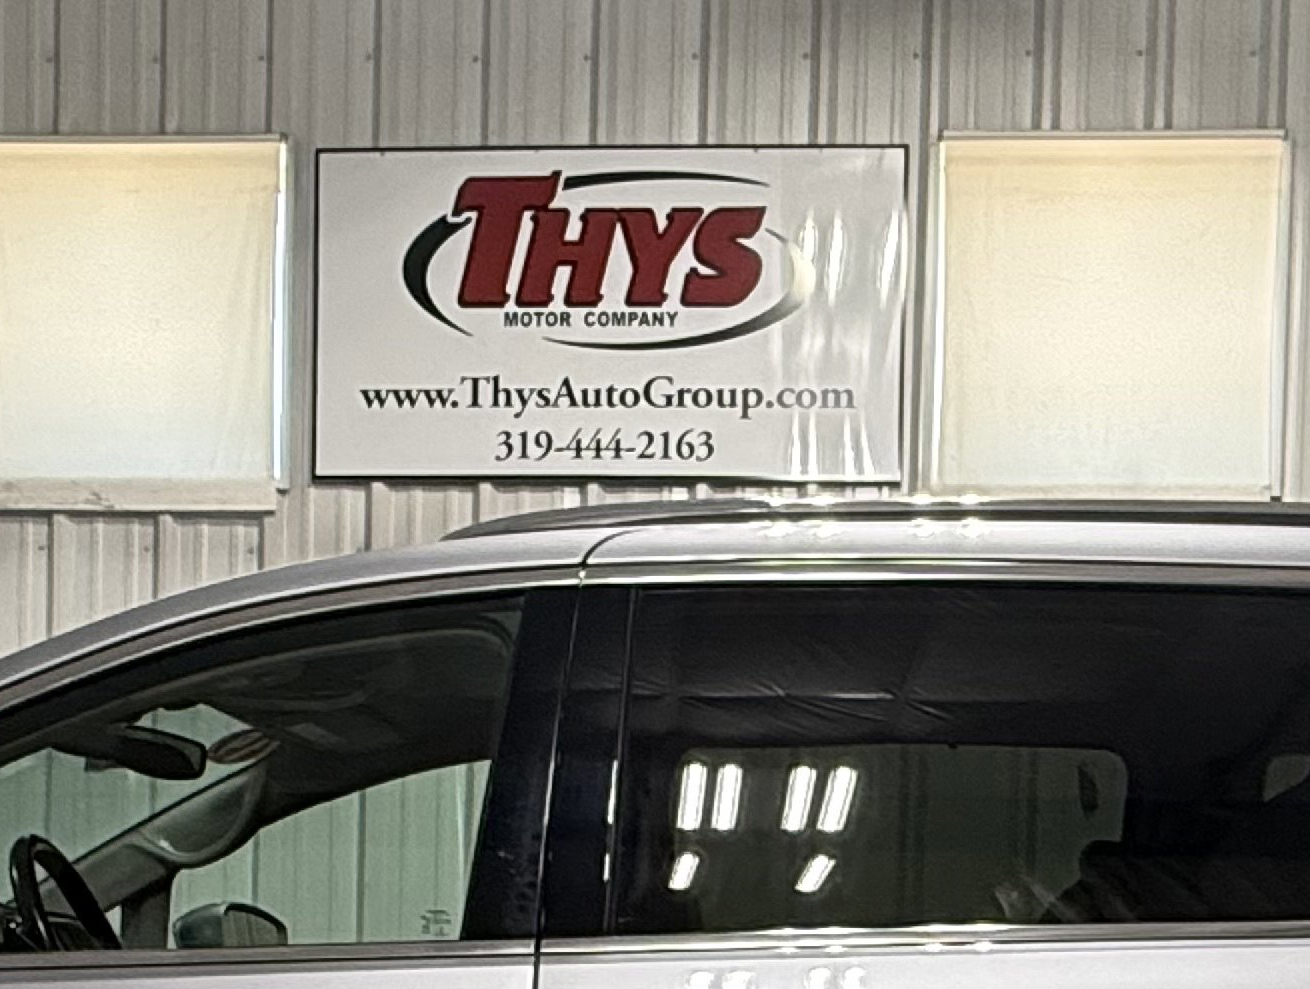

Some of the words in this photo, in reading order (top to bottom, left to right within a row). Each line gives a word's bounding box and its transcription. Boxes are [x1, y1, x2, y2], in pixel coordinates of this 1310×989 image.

[453, 169, 767, 309] THYS
[503, 311, 572, 328] MOTOR
[583, 311, 679, 328] COMPANY
[359, 376, 857, 419] www.ThysAutoGroup.com
[494, 427, 716, 464] 319-444-2163
